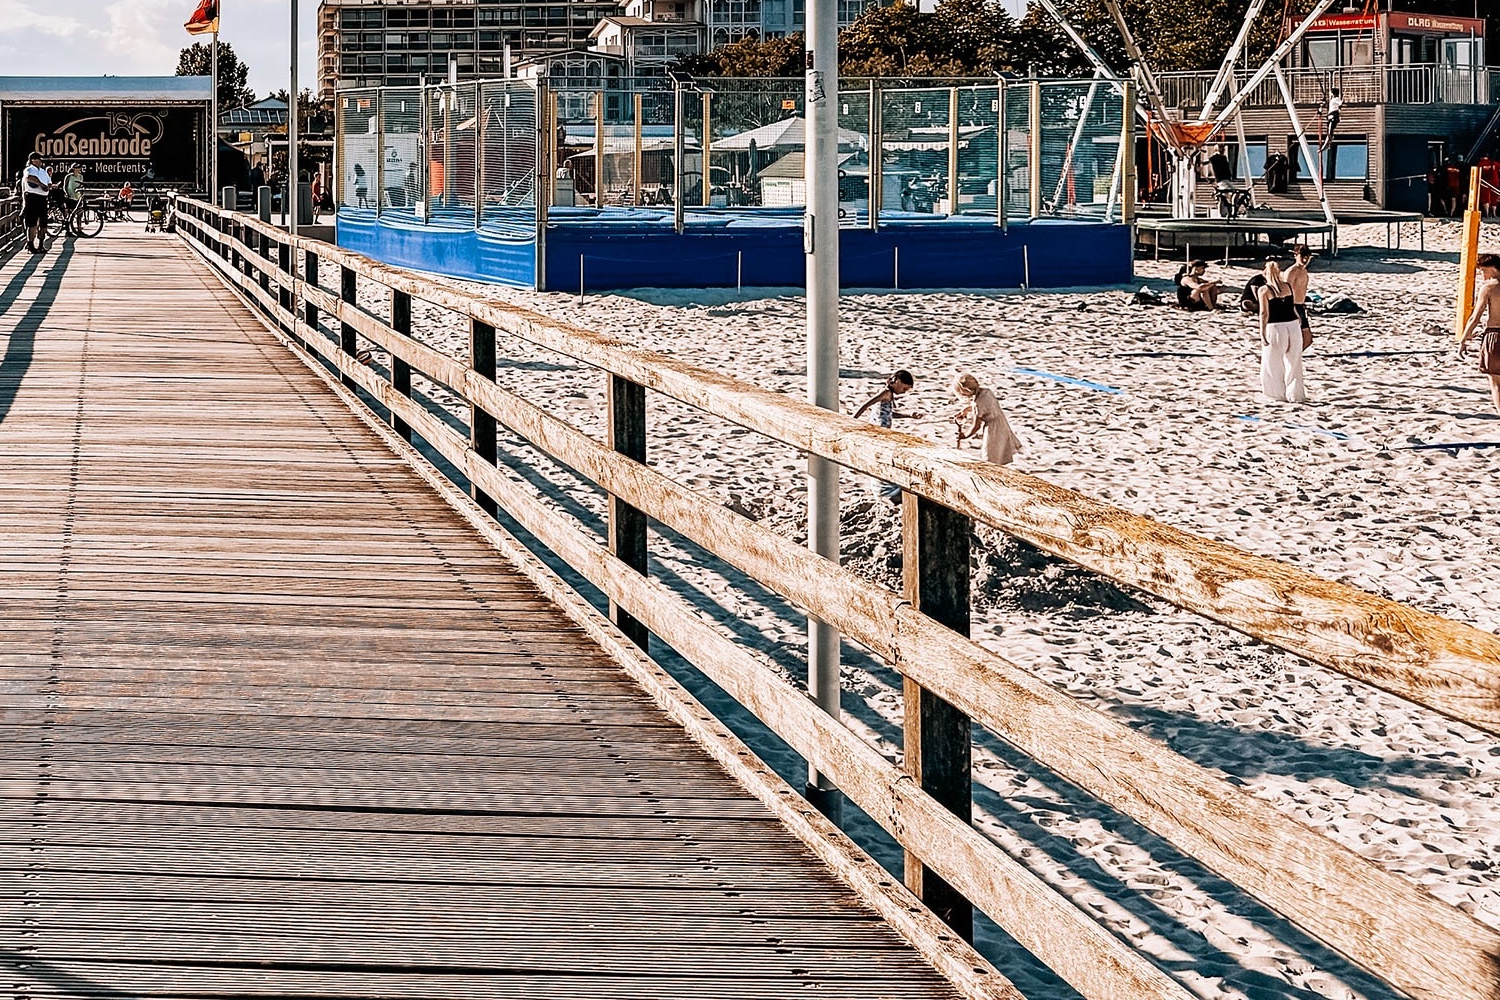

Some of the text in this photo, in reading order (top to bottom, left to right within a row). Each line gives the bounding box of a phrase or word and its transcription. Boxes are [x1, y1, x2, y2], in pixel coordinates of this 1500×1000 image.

[1407, 17, 1431, 28] DLRG
[34, 132, 151, 156] Großenbrode
[95, 161, 147, 173] MeerEvents
